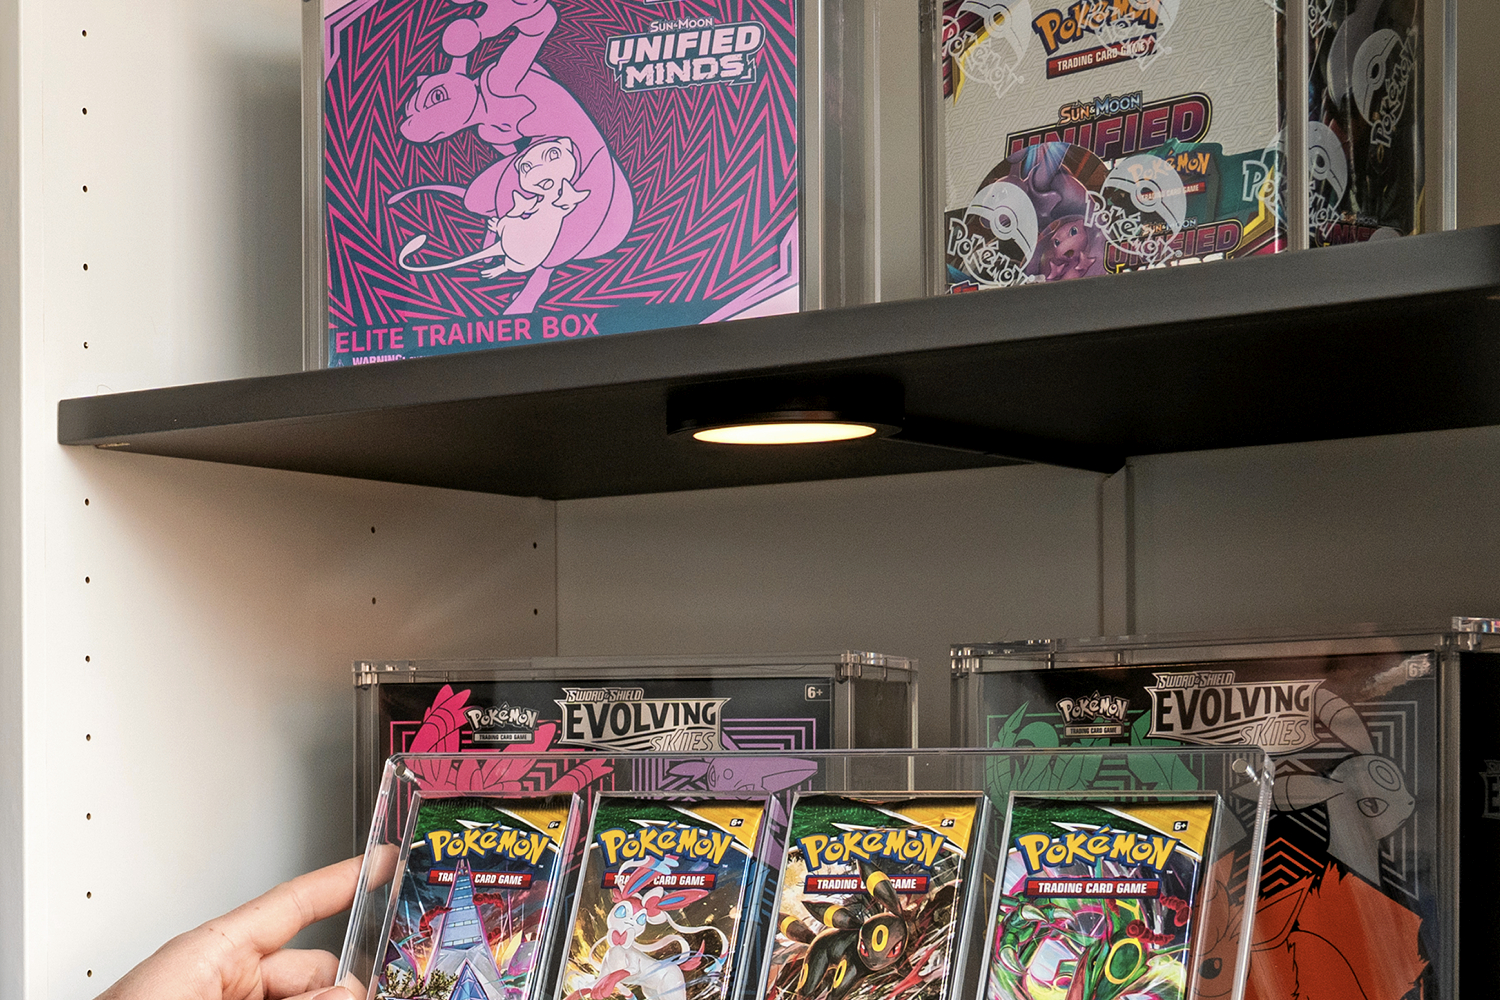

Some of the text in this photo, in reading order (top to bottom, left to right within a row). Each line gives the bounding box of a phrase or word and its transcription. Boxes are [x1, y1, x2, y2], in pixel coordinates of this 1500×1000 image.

[608, 25, 762, 66] UNIFIED
[625, 53, 745, 89] MINDS
[1057, 54, 1093, 71] TRADING
[1095, 47, 1118, 63] CARD
[335, 312, 600, 354] ELITE TRAINER BOX
[807, 686, 823, 698] 6+
[1156, 684, 1309, 732] EVOLVING
[566, 702, 716, 740] EVOLVING
[1070, 727, 1089, 735] TRADING
[1103, 726, 1117, 734] GAME
[1240, 717, 1309, 746] SKIES
[650, 728, 715, 751] SKIES
[940, 819, 953, 827] 6+
[1174, 821, 1187, 830] 6+
[426, 822, 550, 867] Pokémon
[599, 820, 734, 867] Pokémon
[1017, 825, 1180, 873] Pokémon
[474, 874, 523, 885] CARD GAME
[653, 875, 705, 886] CARD GAME
[817, 879, 858, 890] TRADING
[1038, 882, 1148, 894] TRADING CARD GAME
